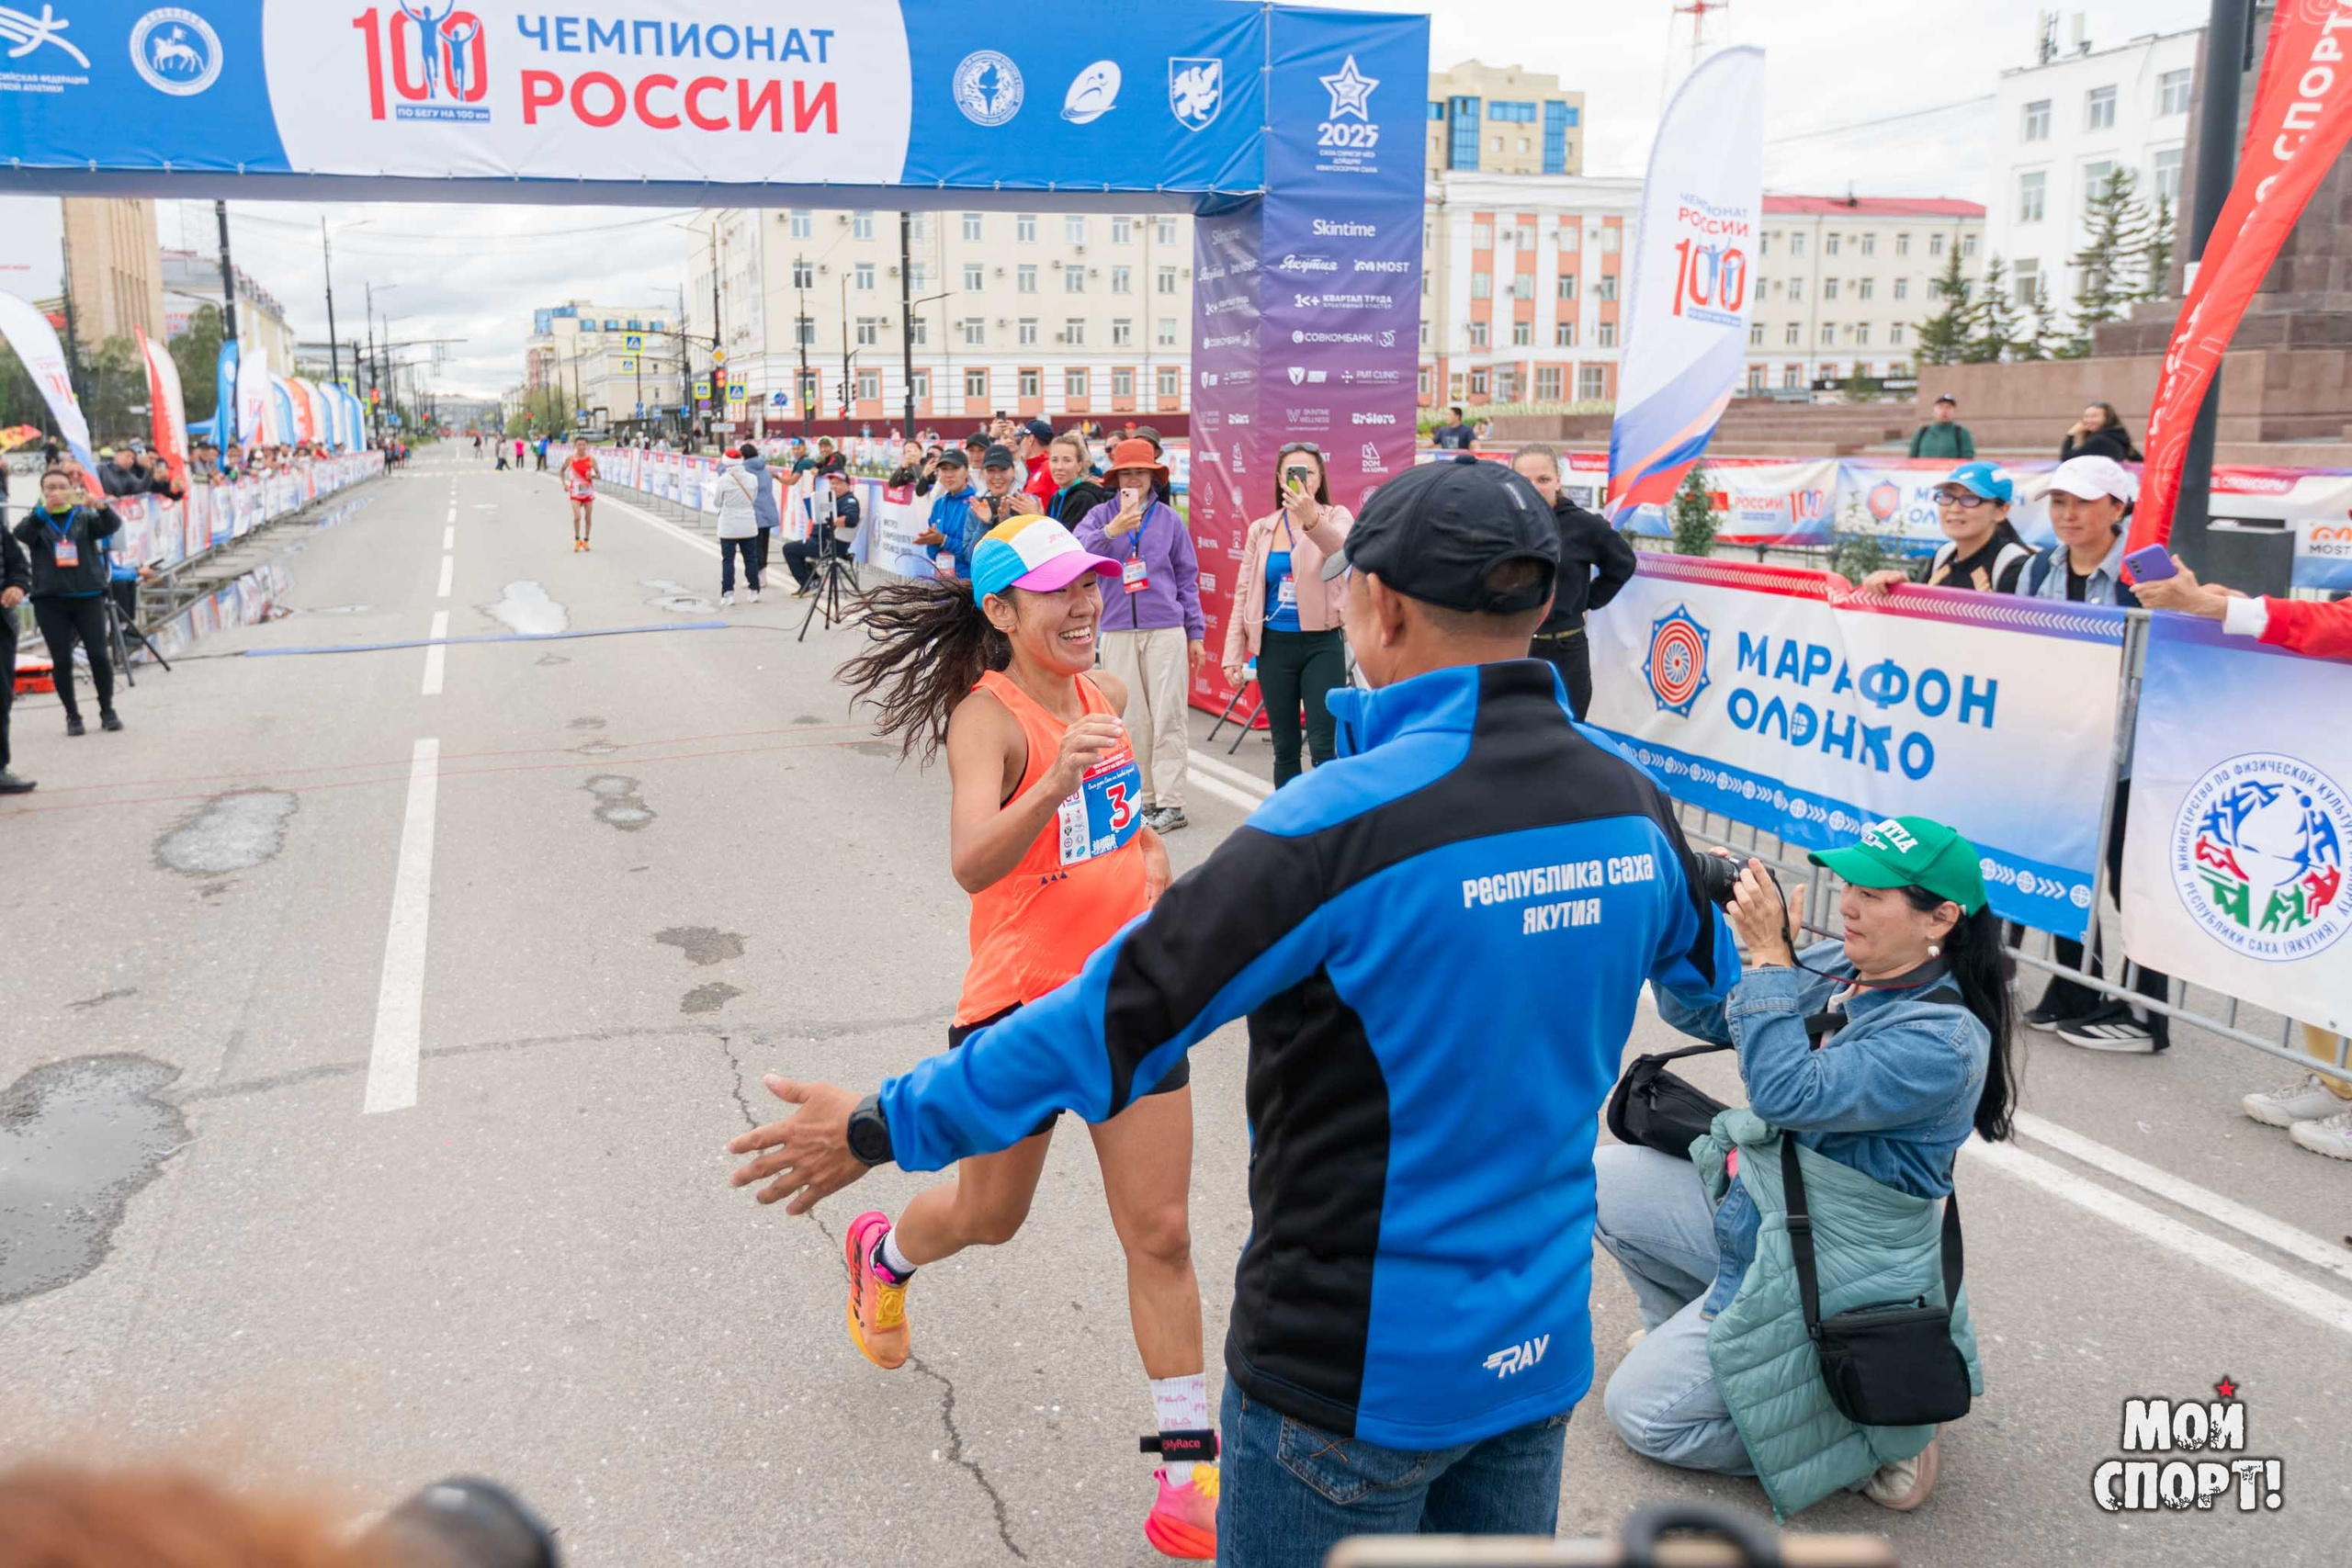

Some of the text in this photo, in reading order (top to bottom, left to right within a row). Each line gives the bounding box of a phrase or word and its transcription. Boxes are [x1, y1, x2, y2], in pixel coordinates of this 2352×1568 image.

[517, 15, 834, 63] ЧЕМПИОНАТ
[353, 7, 488, 120] 100
[397, 107, 413, 117] ПО
[414, 108, 439, 118] БЕГУ
[441, 109, 456, 118] НА
[457, 109, 474, 119] 100
[521, 70, 838, 134] РОССИИ
[1317, 122, 1379, 147] 2025
[1313, 219, 1376, 237] Skintime
[1678, 207, 1749, 238] РОССИИ
[1279, 254, 1339, 274] Якутия
[1376, 262, 1410, 273] MOST
[1673, 239, 1746, 317] 100
[1305, 333, 1373, 344] СОВКОМБАНК
[1735, 496, 1784, 510] РОССИИ
[2309, 545, 2351, 555] MOST
[1737, 631, 1998, 728] МАРАФОН
[2214, 761, 2316, 786] ПО ФИЗИЧЕСКОЙ
[1106, 783, 1131, 829] 3
[2177, 783, 2214, 872] МИНИСТЕРСТВО
[1522, 897, 1600, 935] ЯКУТИЯ
[2184, 882, 2339, 956] РЕСПУБЛИКИ САХА (ЯКУТИЯ)
[1483, 1334, 1550, 1378] RAY
